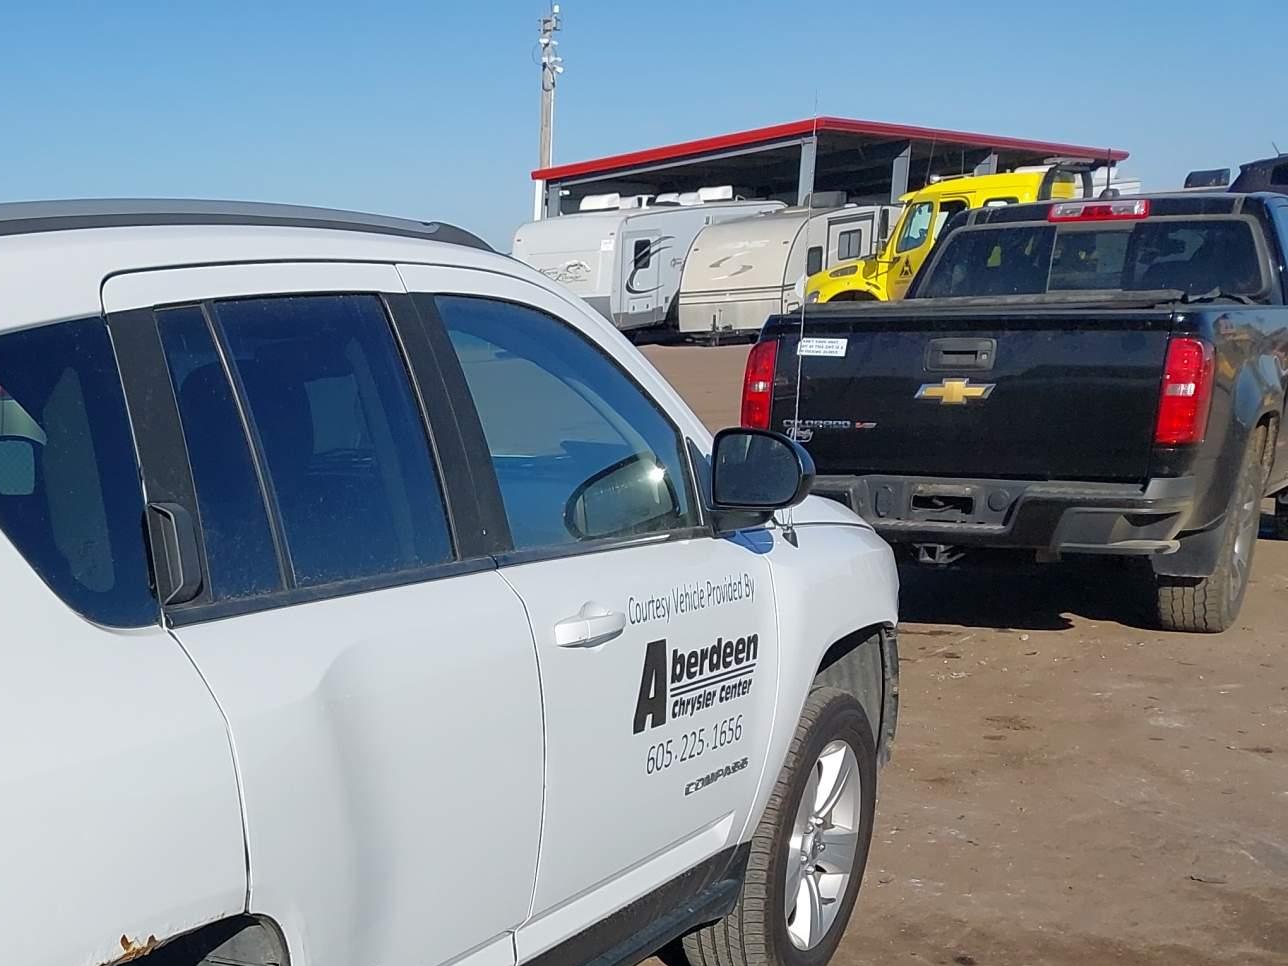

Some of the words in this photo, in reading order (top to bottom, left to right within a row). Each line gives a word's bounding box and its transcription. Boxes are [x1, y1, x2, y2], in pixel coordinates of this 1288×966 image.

[628, 597, 671, 625] Courtesy
[671, 582, 705, 615] Vehicle
[707, 576, 743, 608] Provided
[744, 573, 755, 603] By
[632, 633, 759, 735] Aberdeen
[684, 757, 749, 796] COMPASS
